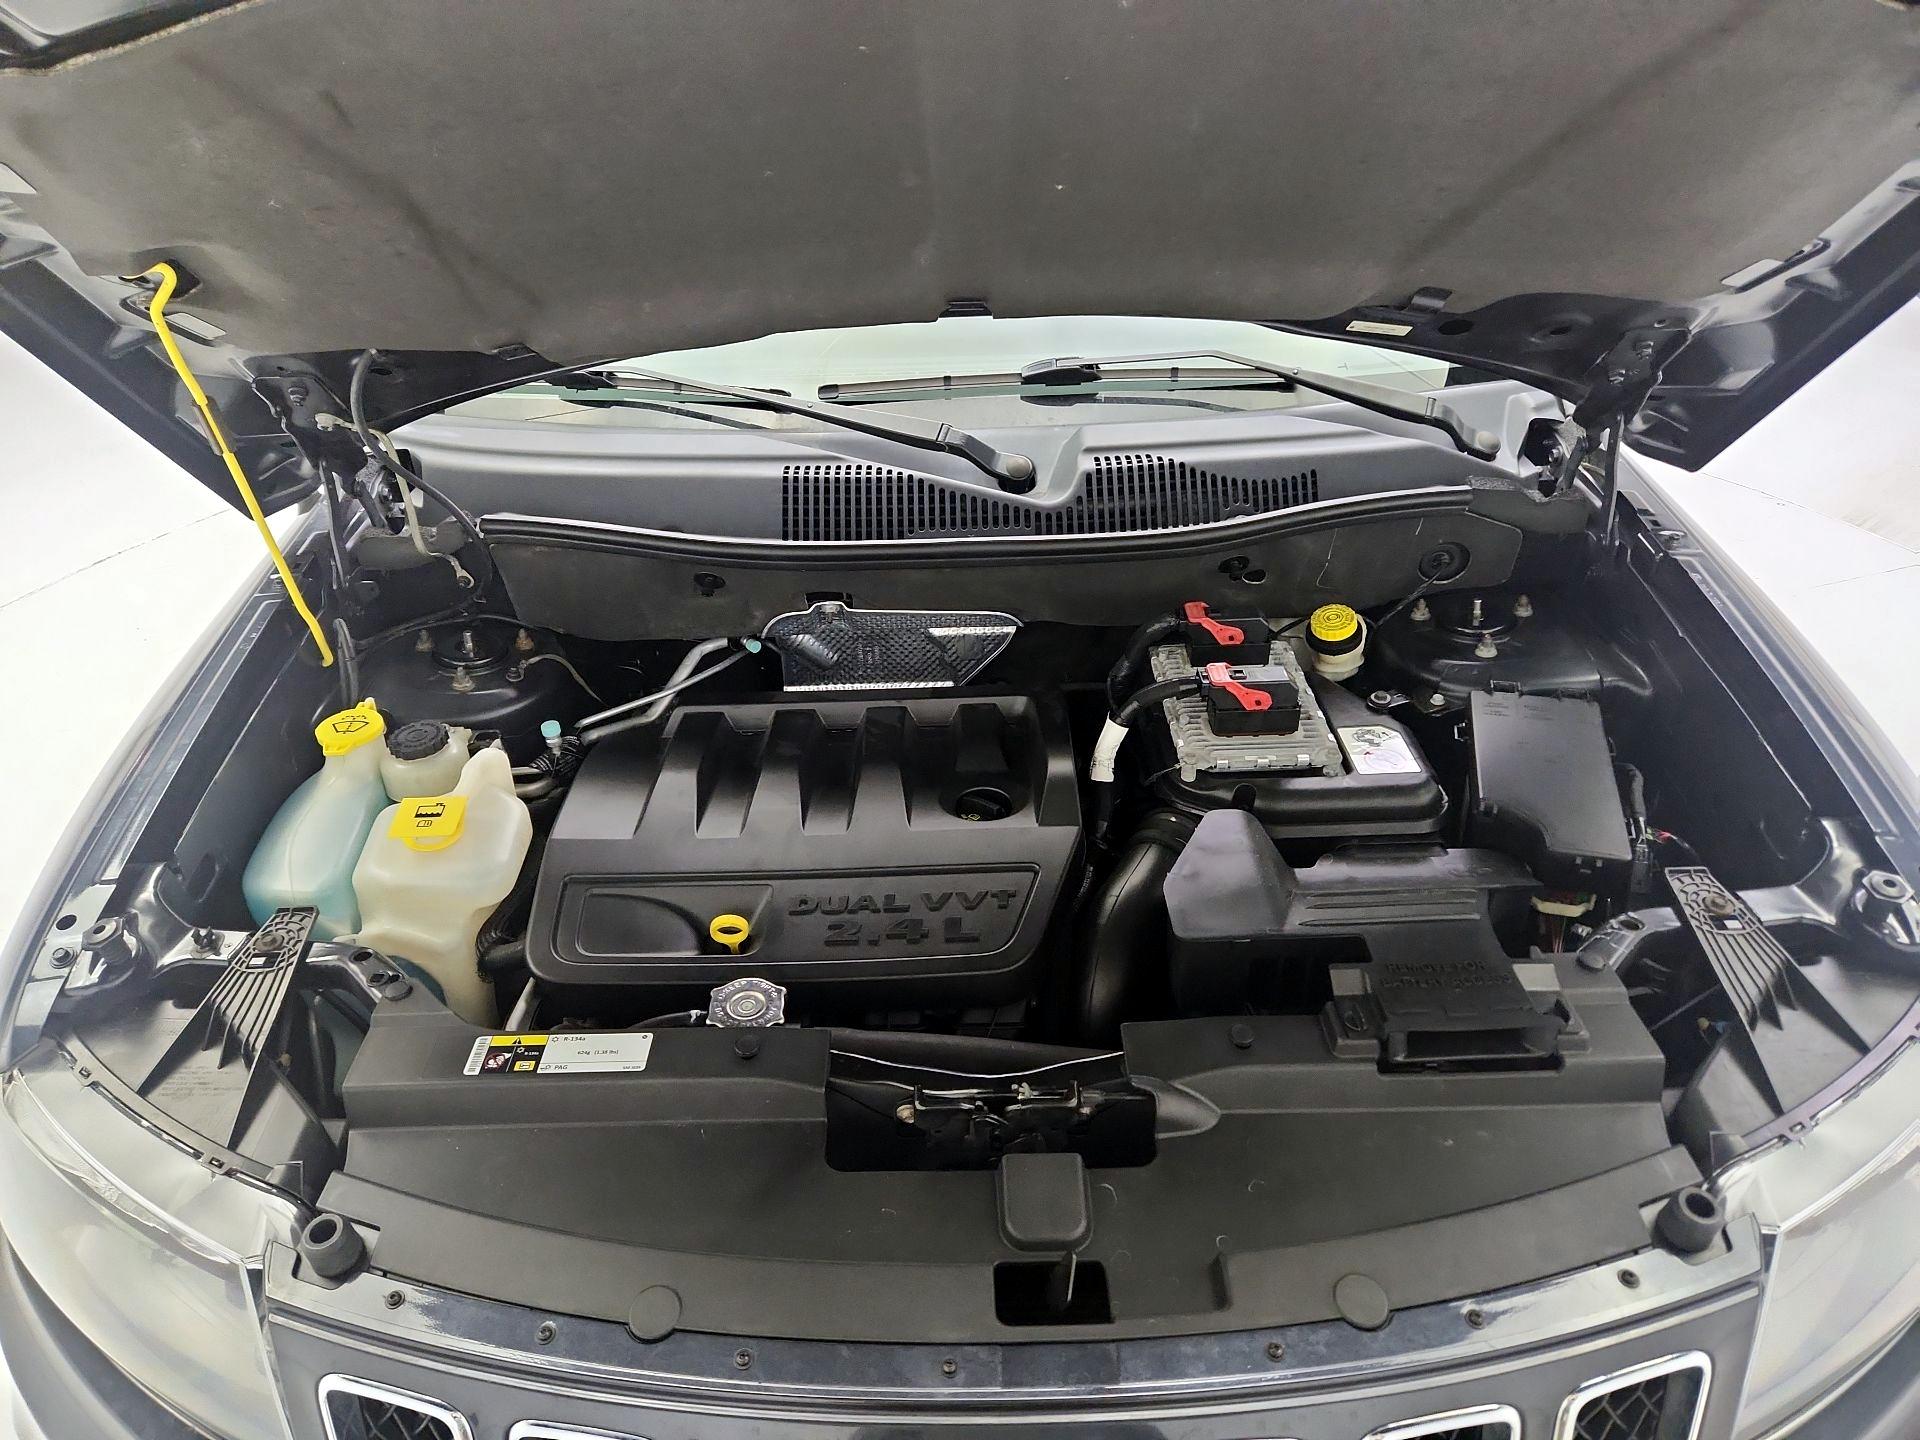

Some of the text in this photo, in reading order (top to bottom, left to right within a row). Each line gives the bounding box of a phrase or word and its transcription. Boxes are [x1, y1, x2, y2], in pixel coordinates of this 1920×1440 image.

[789, 889, 1017, 916] DUAL VVT
[824, 916, 980, 947] 2.4L
